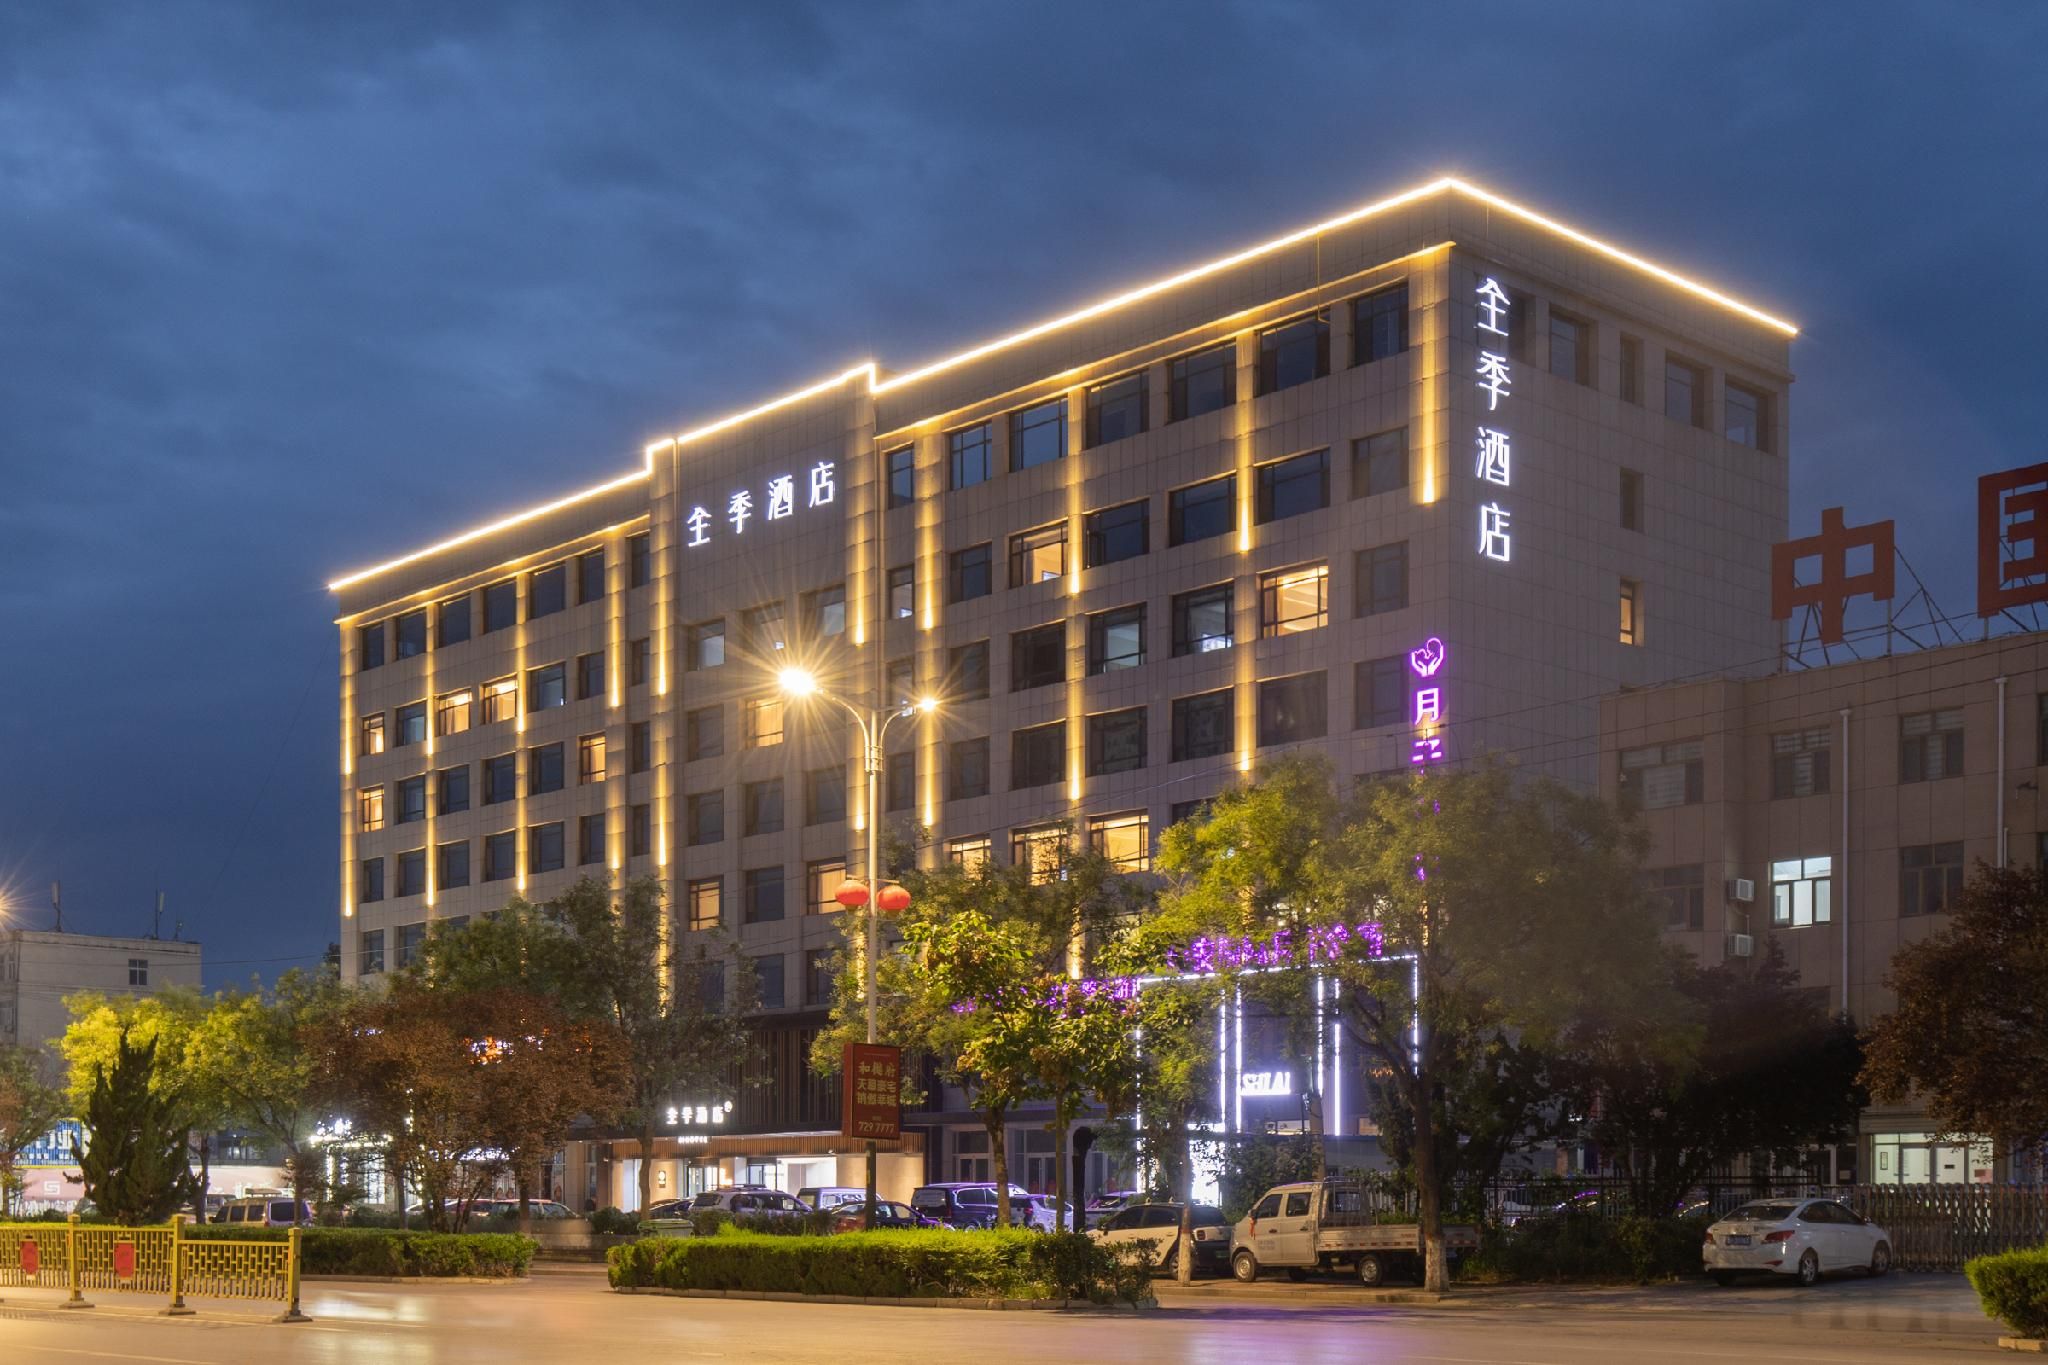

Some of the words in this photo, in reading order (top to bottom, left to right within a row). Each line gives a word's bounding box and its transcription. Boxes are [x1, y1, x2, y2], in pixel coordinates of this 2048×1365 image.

[686, 460, 836, 548] 全季酒店
[1473, 277, 1512, 563] 全季酒店
